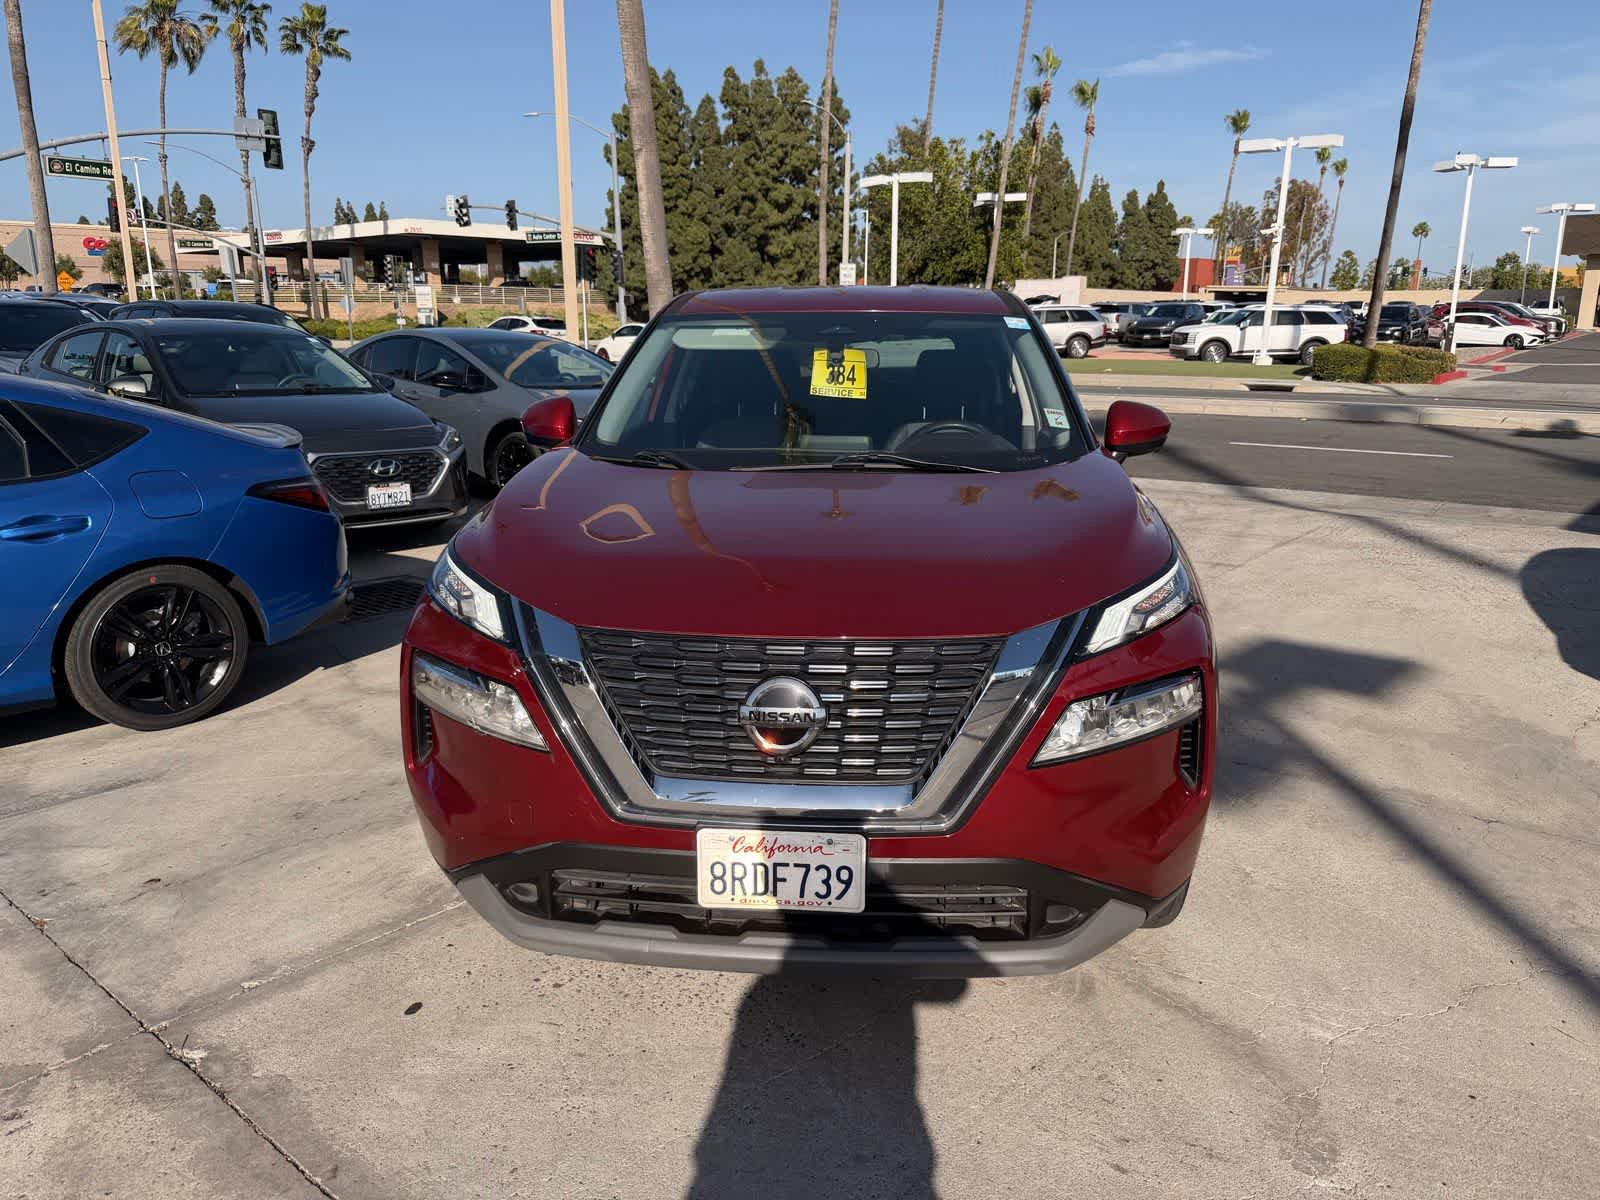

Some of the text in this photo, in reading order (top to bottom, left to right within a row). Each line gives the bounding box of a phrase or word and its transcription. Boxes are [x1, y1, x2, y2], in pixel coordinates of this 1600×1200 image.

[65, 162, 72, 172] El
[75, 163, 100, 175] Camino
[826, 364, 857, 386] 384
[811, 386, 855, 397] SERVICE
[748, 710, 817, 723] NISSAN
[731, 835, 835, 860] California
[709, 860, 854, 901] 8RDF739
